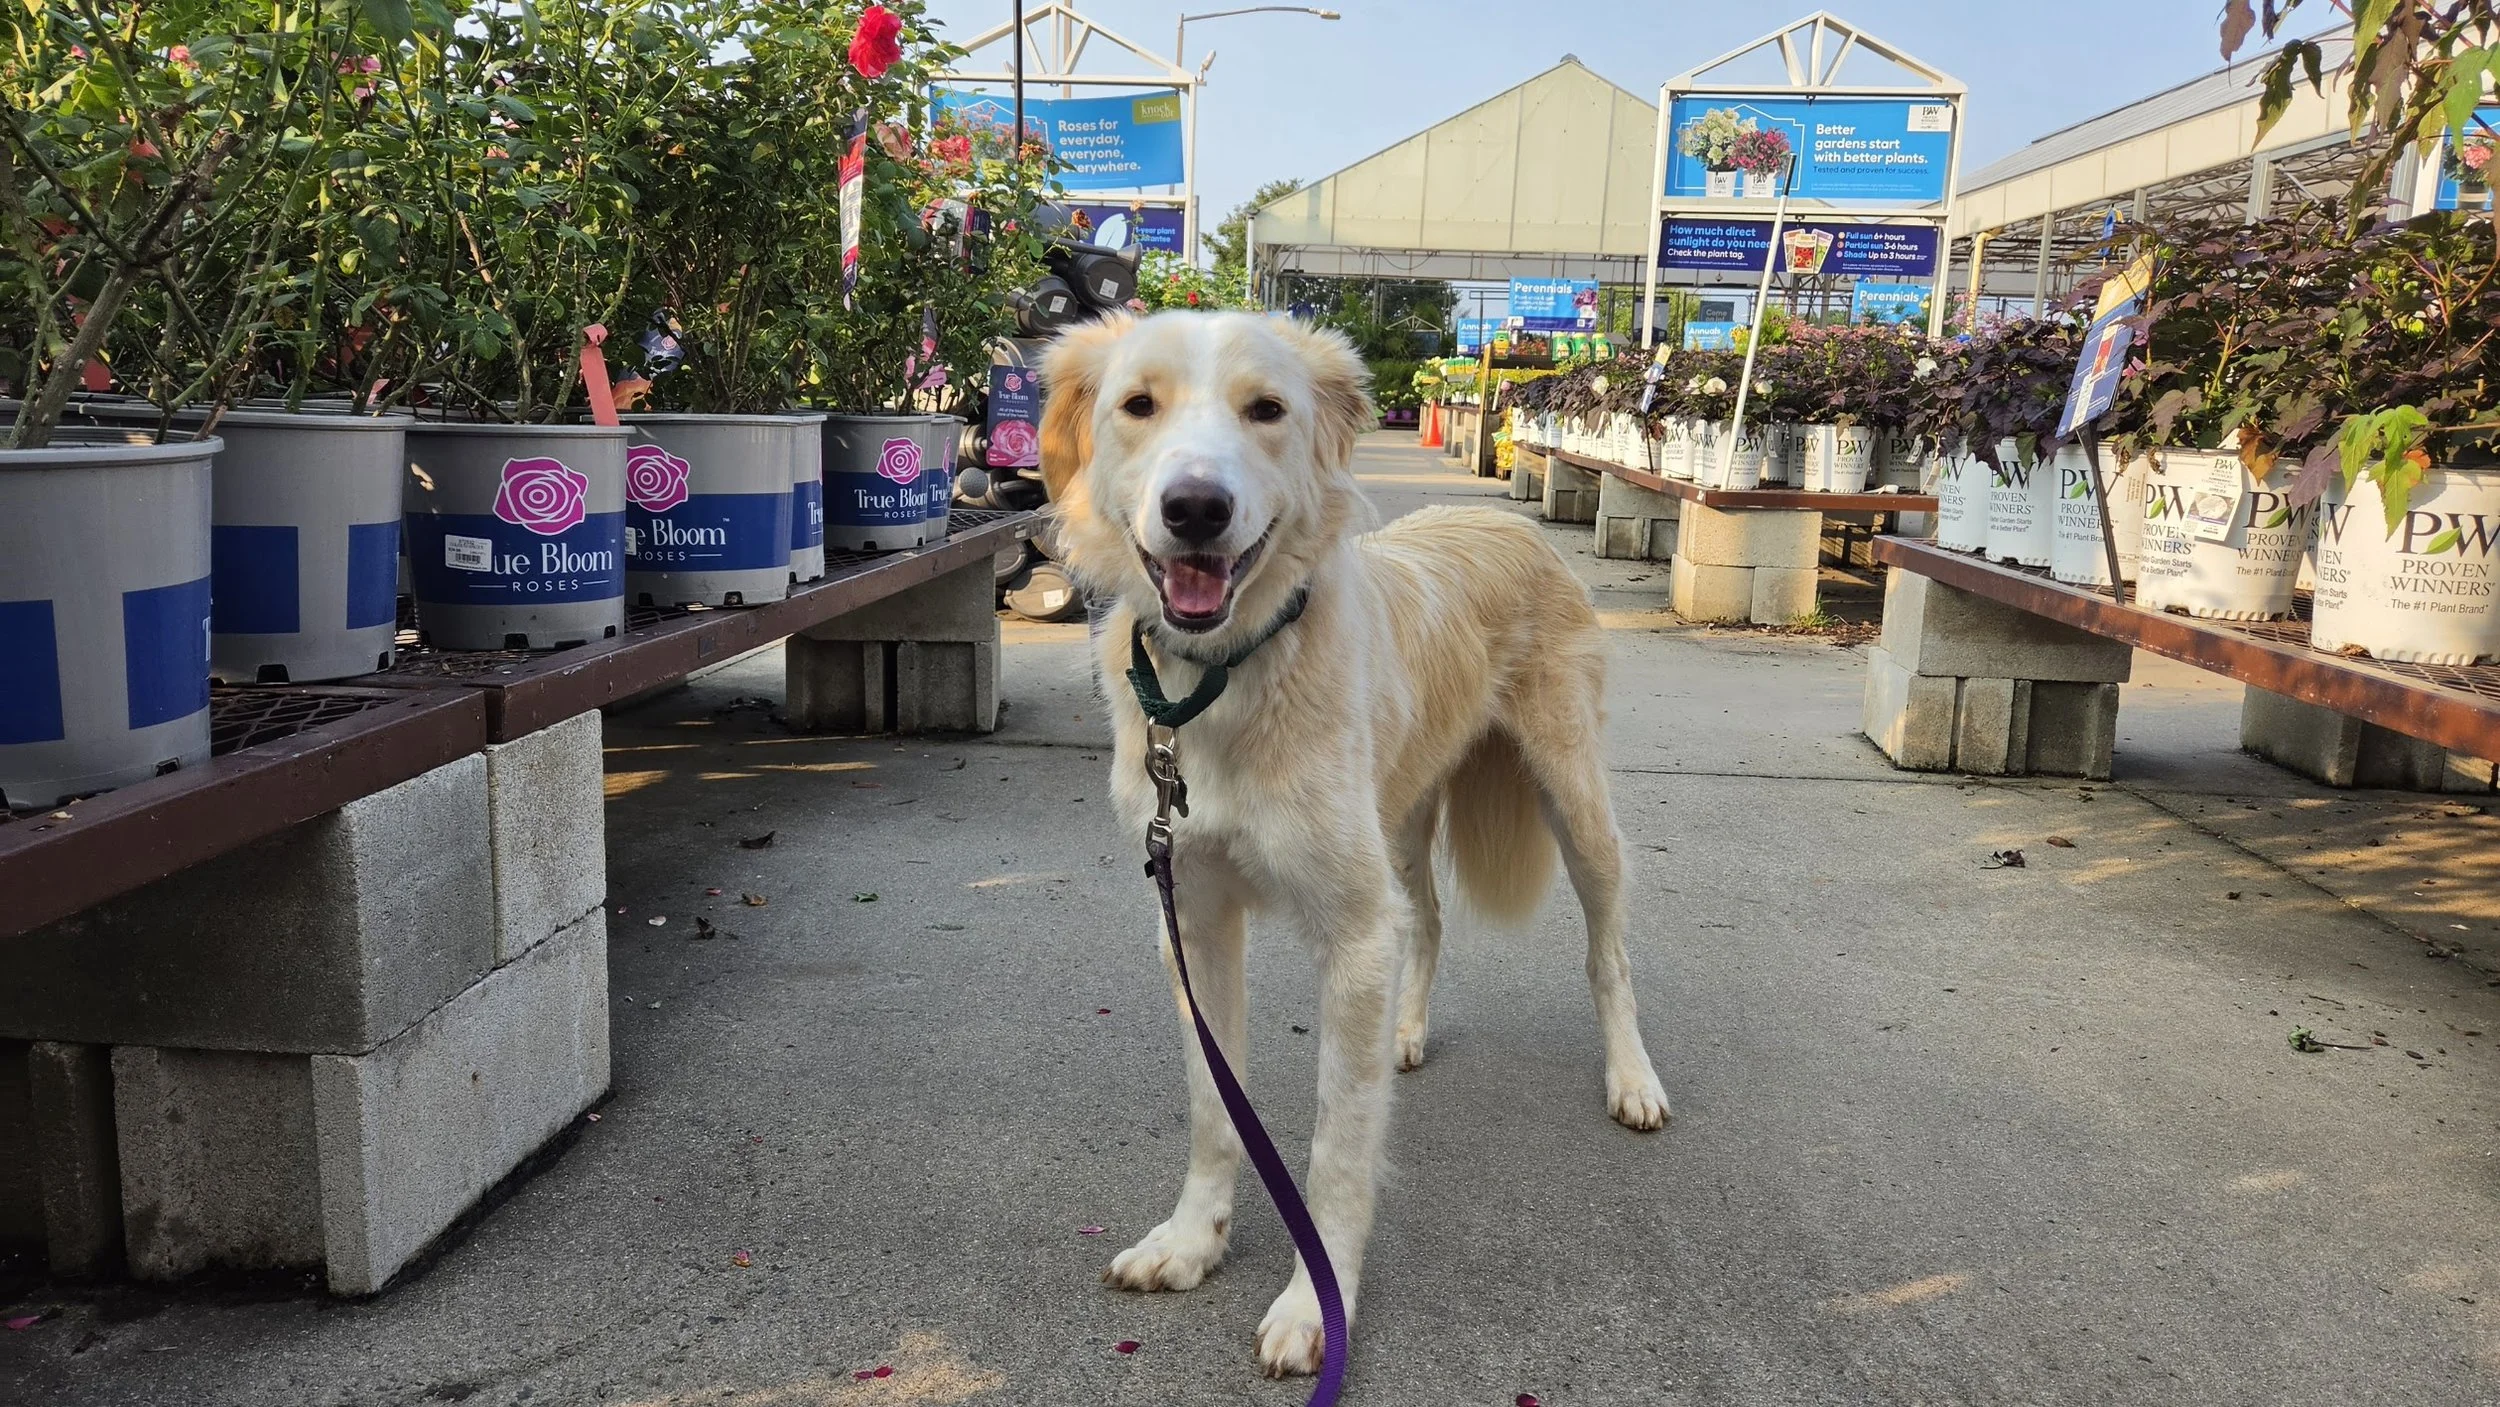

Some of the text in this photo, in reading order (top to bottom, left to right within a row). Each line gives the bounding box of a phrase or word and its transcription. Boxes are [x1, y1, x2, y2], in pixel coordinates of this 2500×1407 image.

[1141, 102, 1170, 115] knock
[1058, 119, 1118, 132] Roses for
[1816, 124, 1856, 135] Better
[1060, 134, 1124, 146] everyday,
[1815, 138, 1900, 150] gardens start
[1060, 148, 1124, 161] everyone,
[1814, 151, 1928, 164] with better plants.
[1062, 161, 1141, 174] eerywhere.
[1813, 166, 1838, 174] Tested
[1840, 166, 1856, 174] and
[1157, 227, 1176, 236] plant
[1670, 225, 1756, 237] How much direct
[1668, 237, 1710, 248] sunlight
[1712, 237, 1724, 247] do
[1727, 240, 1746, 250] you
[1884, 242, 1896, 250] 3-6
[1667, 248, 1692, 256] Check
[1708, 249, 1728, 258] plant
[1730, 251, 1744, 260] tag.
[1844, 250, 1867, 258] Shade
[1868, 252, 1879, 260] Up
[1895, 252, 1916, 260] hours
[1514, 282, 1572, 294] Perennials
[1860, 290, 1920, 302] Perennials
[1734, 438, 1763, 452] PW
[1837, 440, 1868, 454] PW
[2214, 459, 2237, 470] PW
[854, 488, 895, 508] True
[2144, 484, 2184, 522] PW
[808, 502, 823, 525] Tru
[884, 510, 916, 518] ROSES
[2060, 503, 2106, 516] PROVE
[2243, 491, 2317, 530] PW
[2323, 503, 2356, 546] W
[2074, 532, 2089, 541] Plant
[2090, 534, 2106, 542] Bra
[2396, 510, 2500, 559] PW
[494, 554, 531, 575] ue
[541, 542, 613, 574] Bloom
[2172, 558, 2192, 568] Starts
[2236, 566, 2251, 576] The
[2254, 567, 2263, 576] #1
[2266, 568, 2281, 576] Plant
[2402, 559, 2490, 578] PROVEN
[512, 579, 579, 592] ROSES
[2391, 577, 2491, 596] WINNERS
[2329, 588, 2348, 599] Starts
[2392, 599, 2485, 614] The #1 Plant Brand
